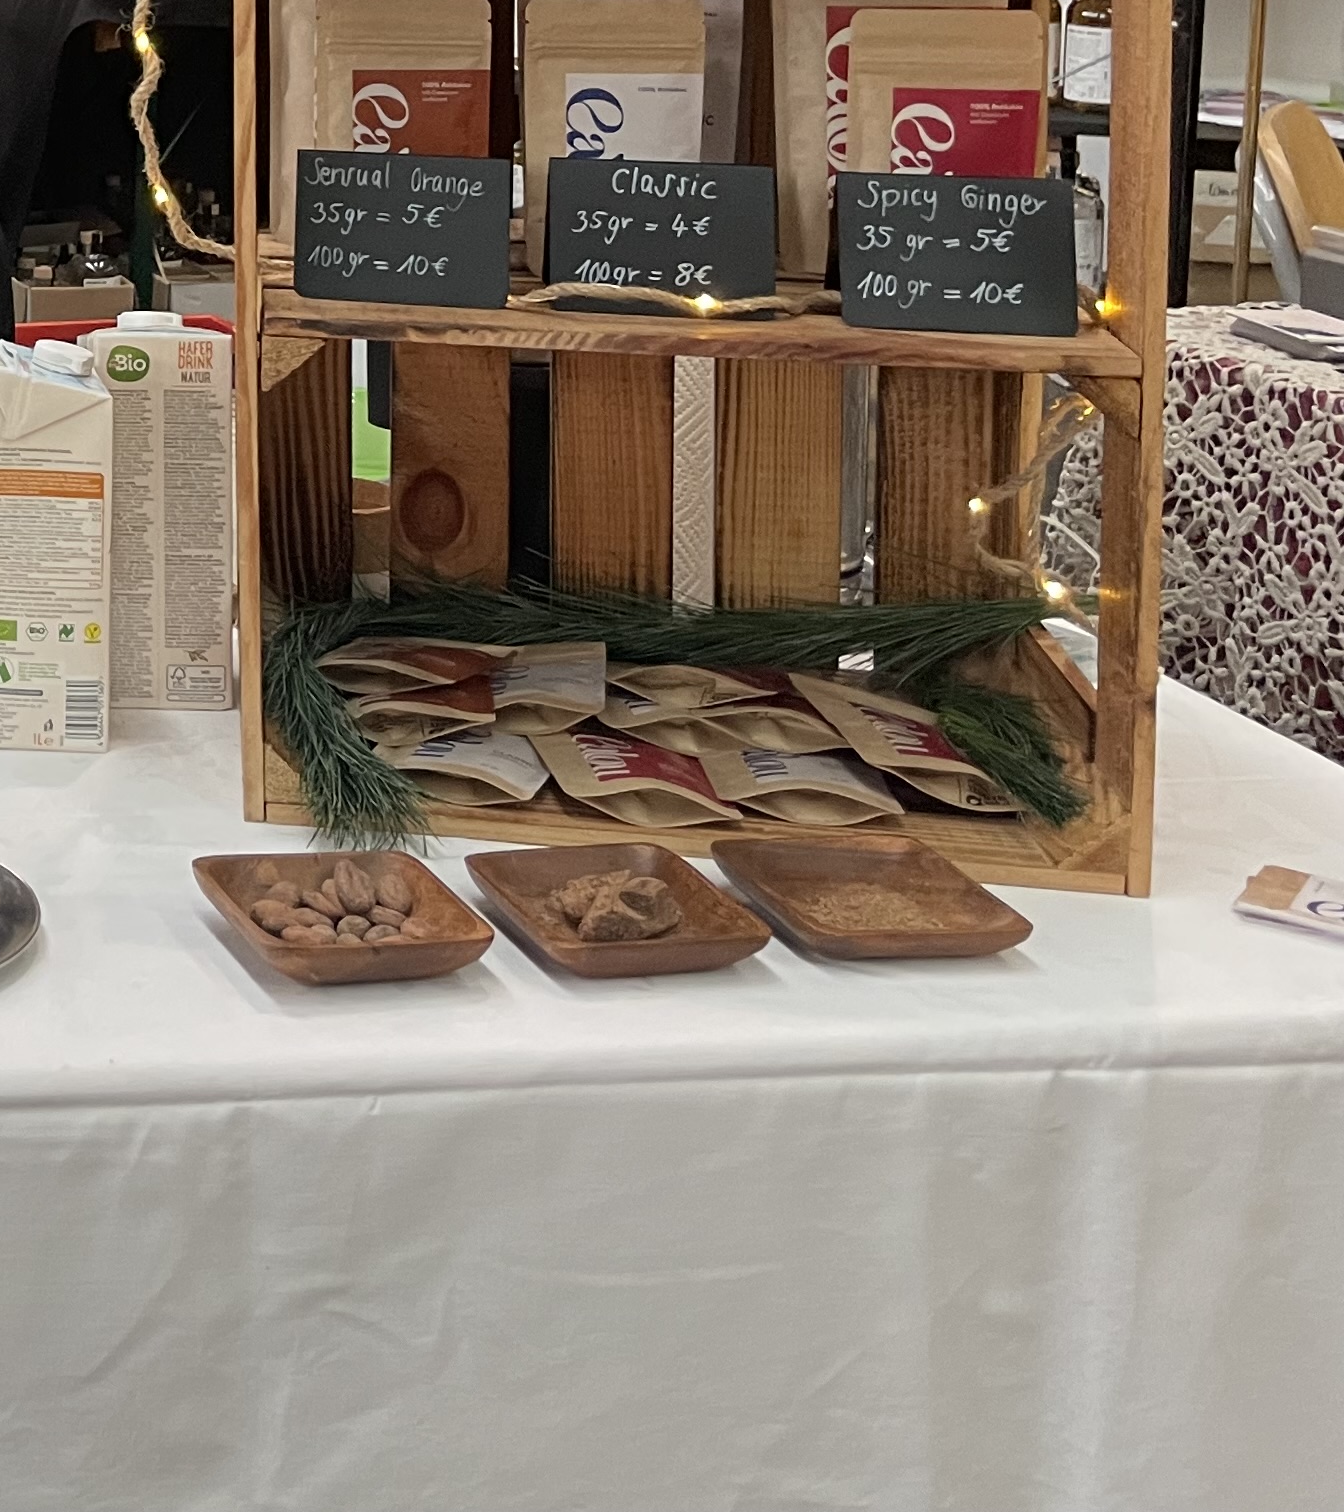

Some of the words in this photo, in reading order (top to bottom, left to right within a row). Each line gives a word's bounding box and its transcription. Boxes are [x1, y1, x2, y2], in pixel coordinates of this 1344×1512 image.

[304, 157, 390, 189] Sensual
[411, 167, 485, 212] Orange
[612, 167, 717, 200] Classic
[401, 203, 445, 228] 5€
[857, 180, 937, 221] Spicy
[961, 184, 1048, 229] Ginger
[671, 214, 711, 237] 4€
[970, 228, 1014, 252] 5€
[396, 255, 449, 276] 10€
[674, 263, 712, 286] 8€
[970, 281, 1024, 305] 10€
[178, 341, 213, 354] HAFER
[178, 354, 213, 369] DRINK
[181, 371, 212, 384] NATUR
